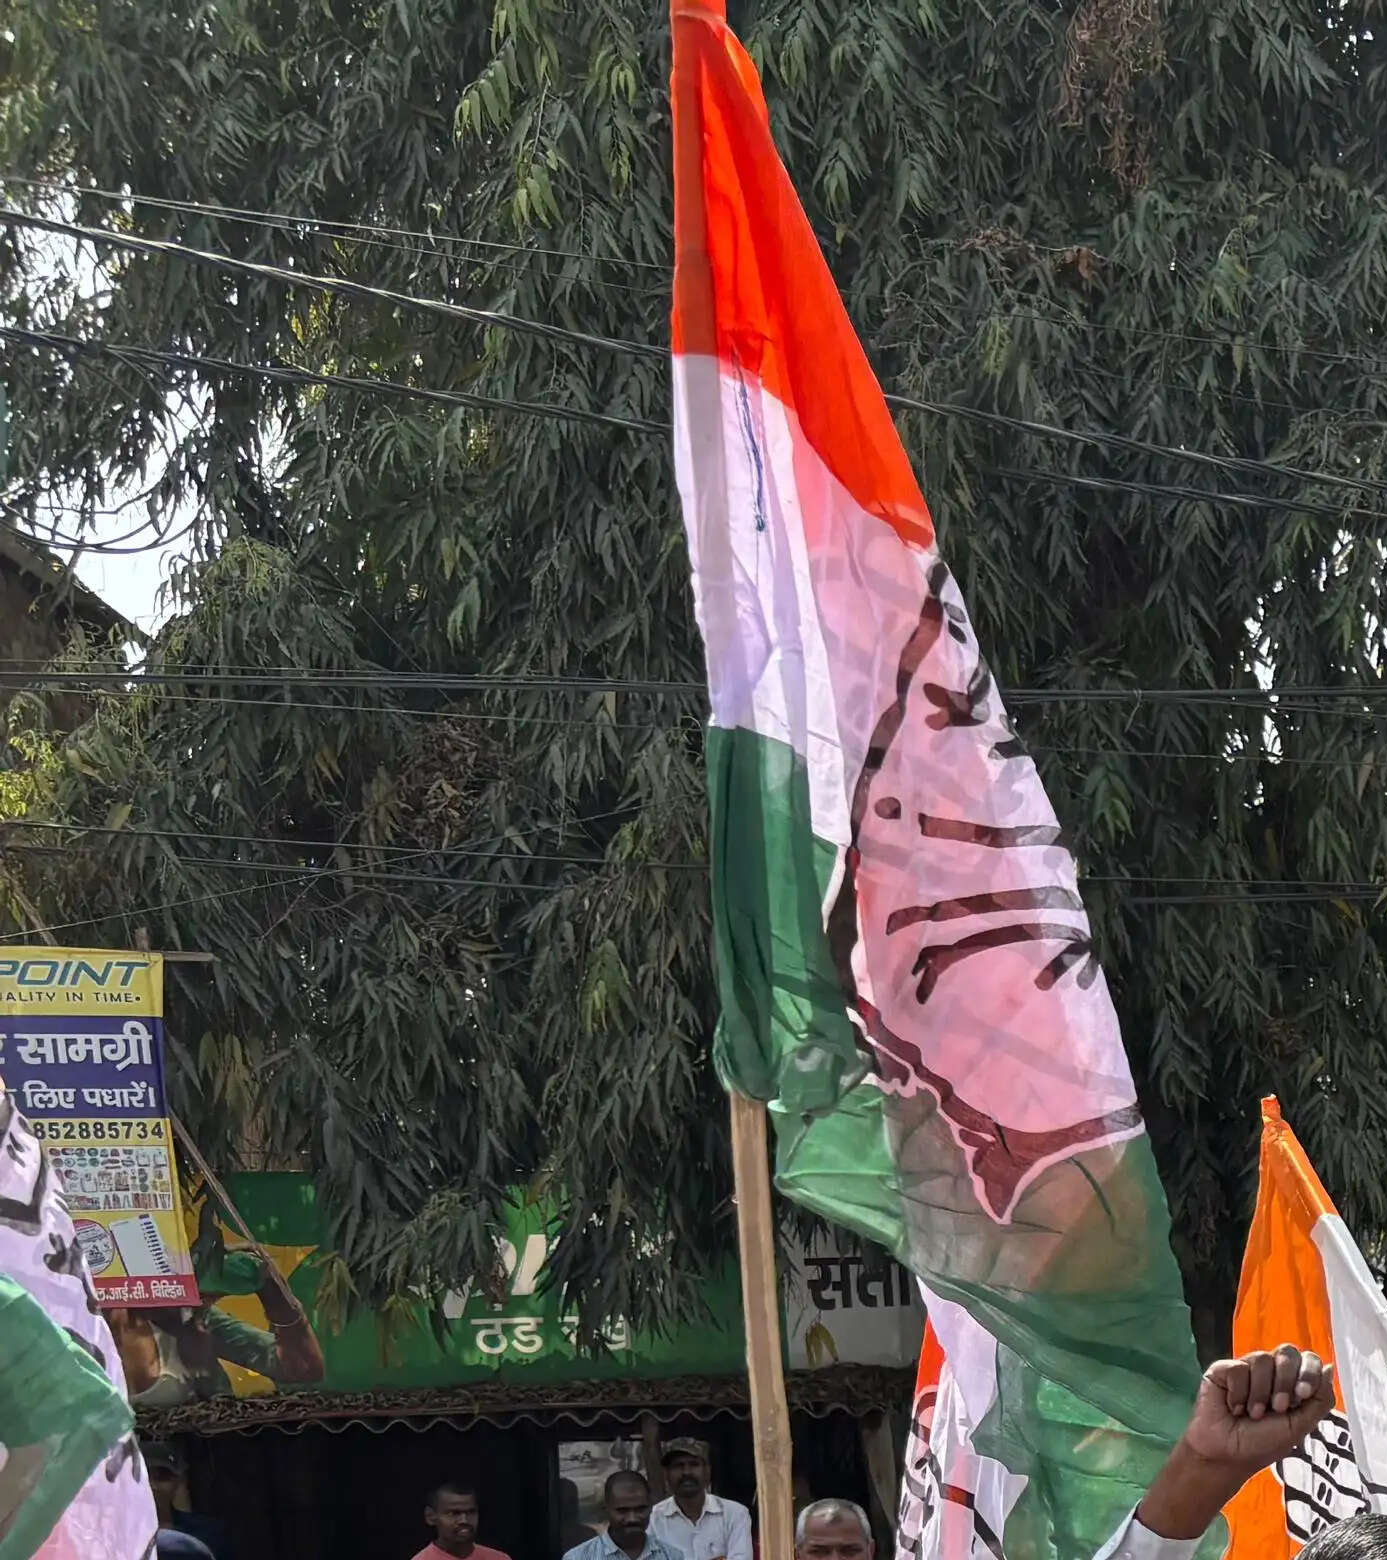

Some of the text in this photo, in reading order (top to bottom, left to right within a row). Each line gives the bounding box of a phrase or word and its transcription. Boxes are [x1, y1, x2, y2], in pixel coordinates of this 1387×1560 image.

[66, 992, 84, 1002] IN
[14, 1020, 153, 1071] सामग्री
[22, 1079, 77, 1109] लिए
[33, 1121, 164, 1141] 852885734
